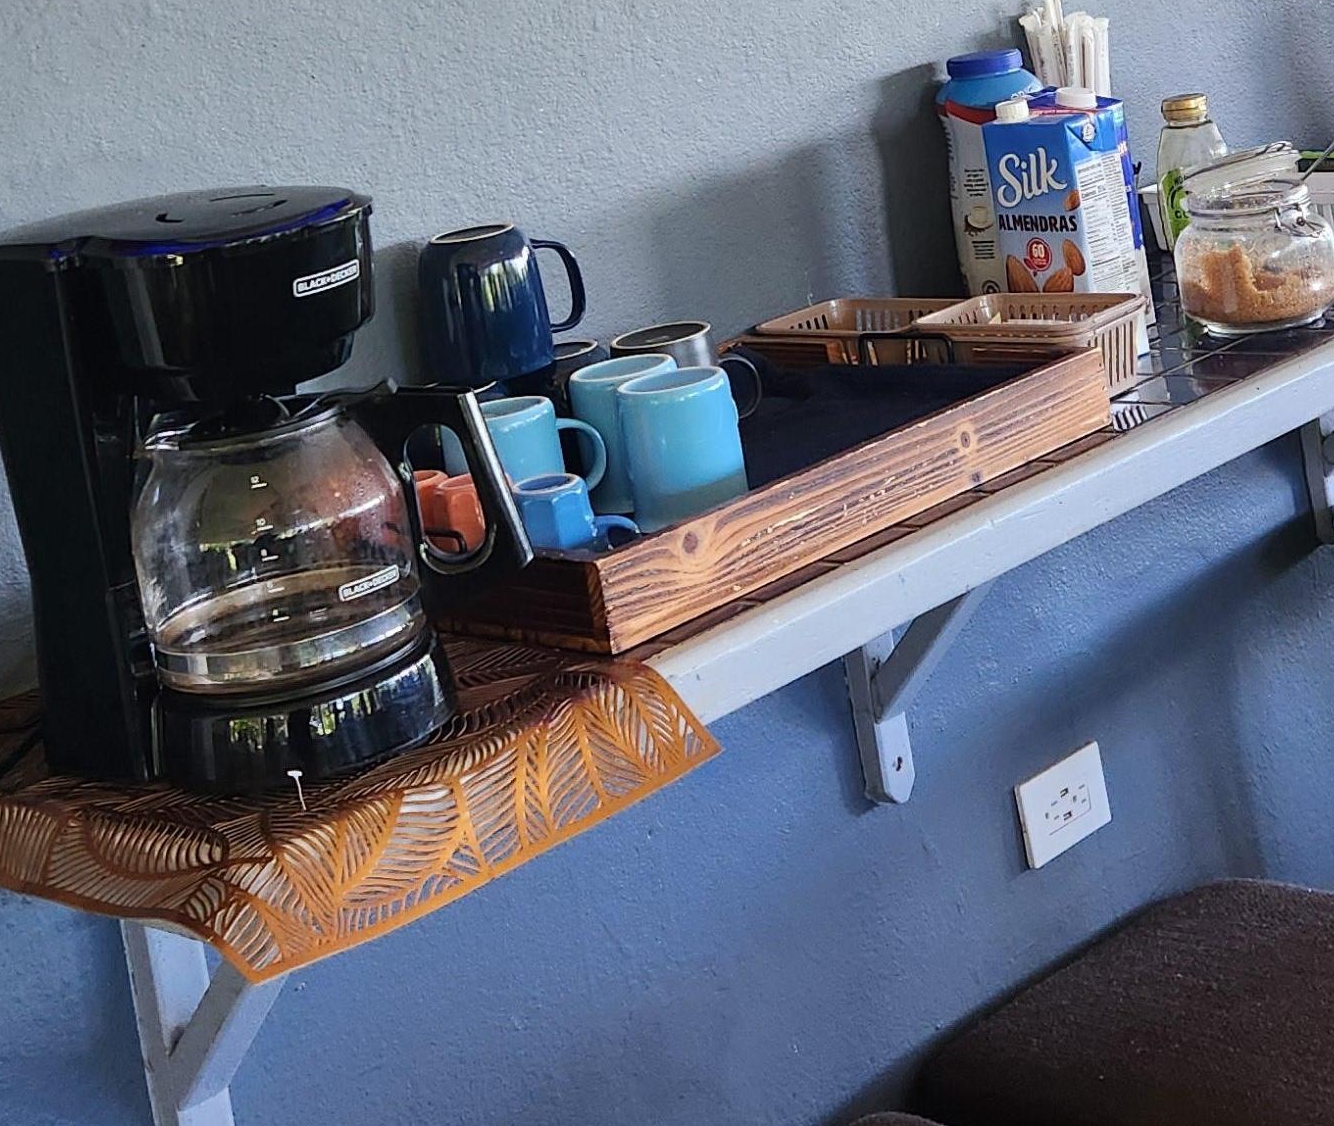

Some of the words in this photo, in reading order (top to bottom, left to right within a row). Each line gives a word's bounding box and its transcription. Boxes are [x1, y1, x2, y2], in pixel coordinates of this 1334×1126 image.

[997, 146, 1068, 208] Silk
[998, 212, 1078, 232] ALMENDRAS
[1032, 242, 1046, 259] 60
[255, 517, 266, 526] 10
